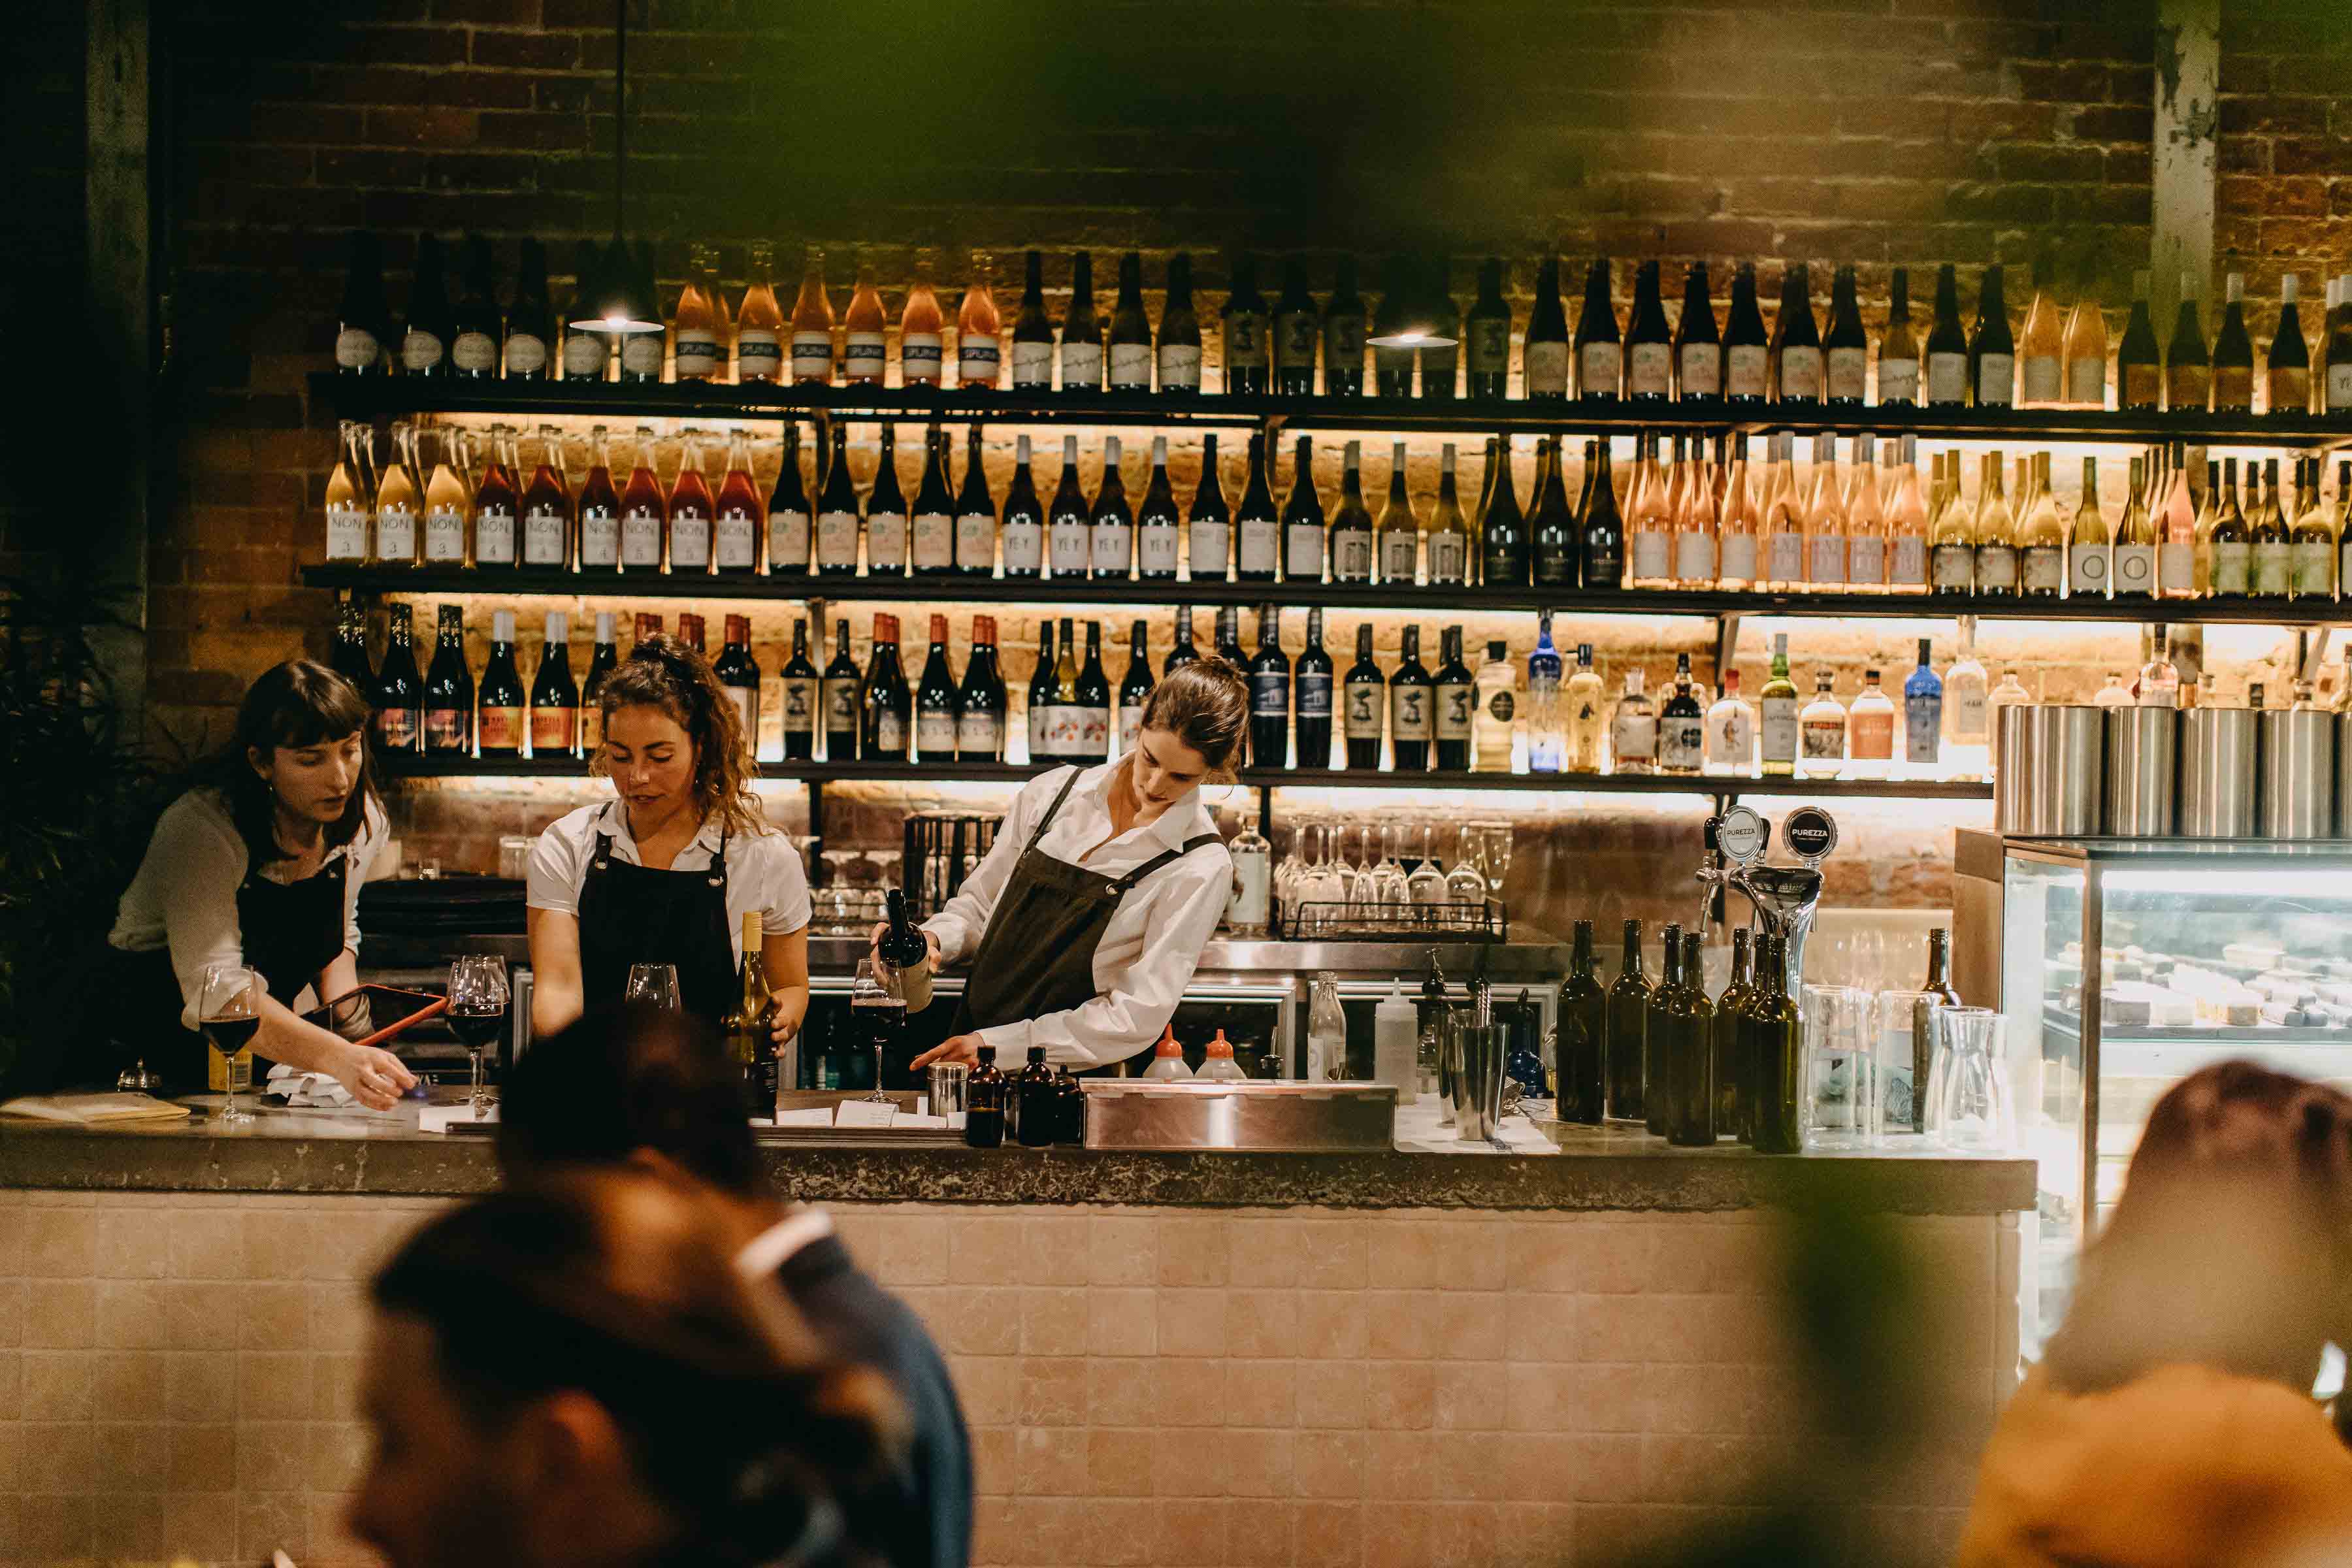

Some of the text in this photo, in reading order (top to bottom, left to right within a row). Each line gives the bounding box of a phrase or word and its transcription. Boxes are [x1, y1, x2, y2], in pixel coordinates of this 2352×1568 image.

[333, 517, 361, 530] NON
[381, 517, 409, 530] NON
[429, 517, 457, 530] NON
[479, 519, 508, 533] NON
[626, 523, 655, 535] NON
[1792, 828, 1828, 837] PUREZZA
